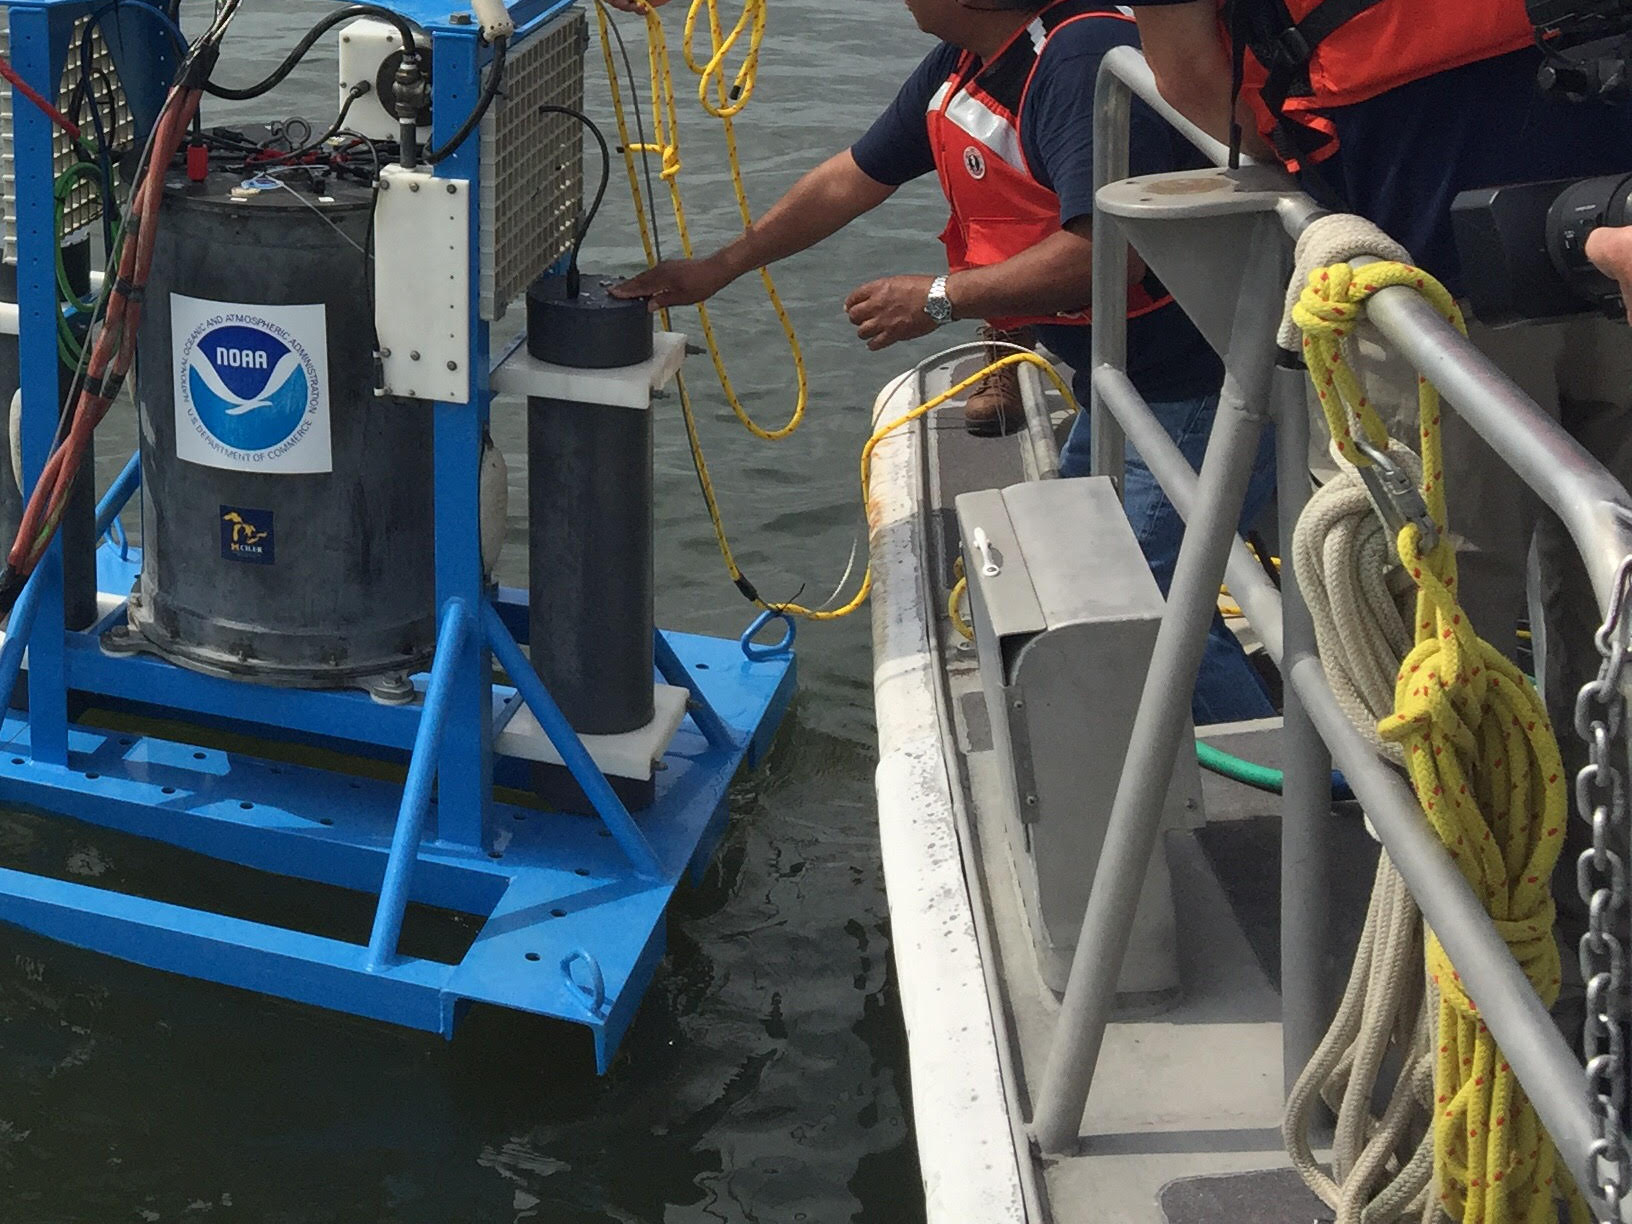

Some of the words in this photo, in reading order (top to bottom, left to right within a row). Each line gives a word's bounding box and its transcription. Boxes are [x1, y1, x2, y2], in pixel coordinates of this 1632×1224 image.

[206, 314, 224, 329] AND
[225, 313, 291, 341] ATMOSPHERIC
[183, 322, 207, 356] OCEANIC
[216, 347, 268, 369] NOAA
[180, 357, 189, 403] NATIONAL
[288, 338, 320, 415] ADMINISTRATION
[195, 424, 251, 462] DEPARTMENT
[251, 452, 266, 463] OF
[267, 419, 313, 461] COMMERCE
